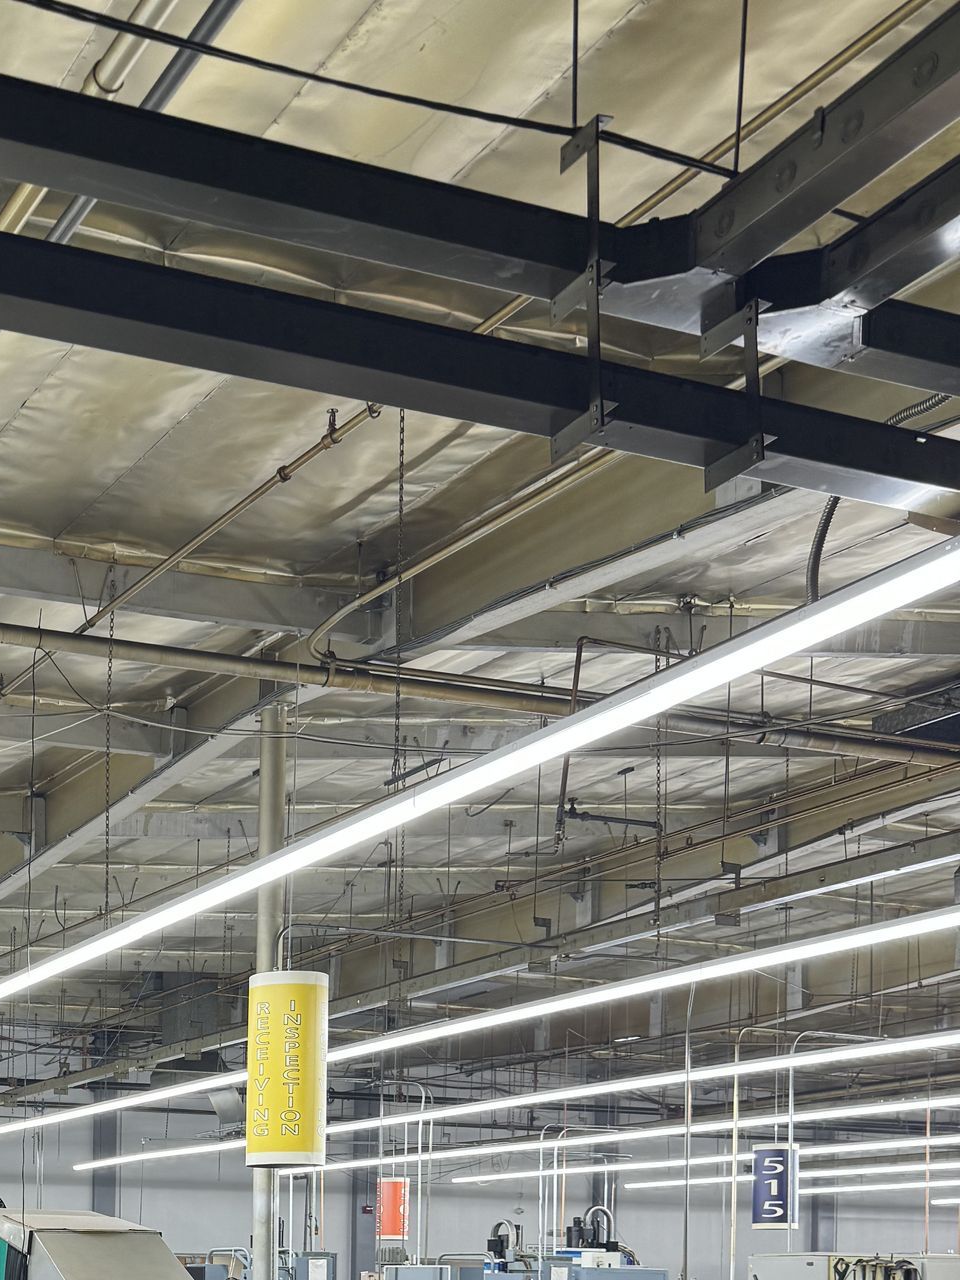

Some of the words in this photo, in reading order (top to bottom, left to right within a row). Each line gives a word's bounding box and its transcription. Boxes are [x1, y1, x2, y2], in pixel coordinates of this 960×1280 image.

[252, 1001, 271, 1137] RECEIVING
[280, 999, 302, 1136] INSPECTION
[761, 1157, 785, 1218] 515
